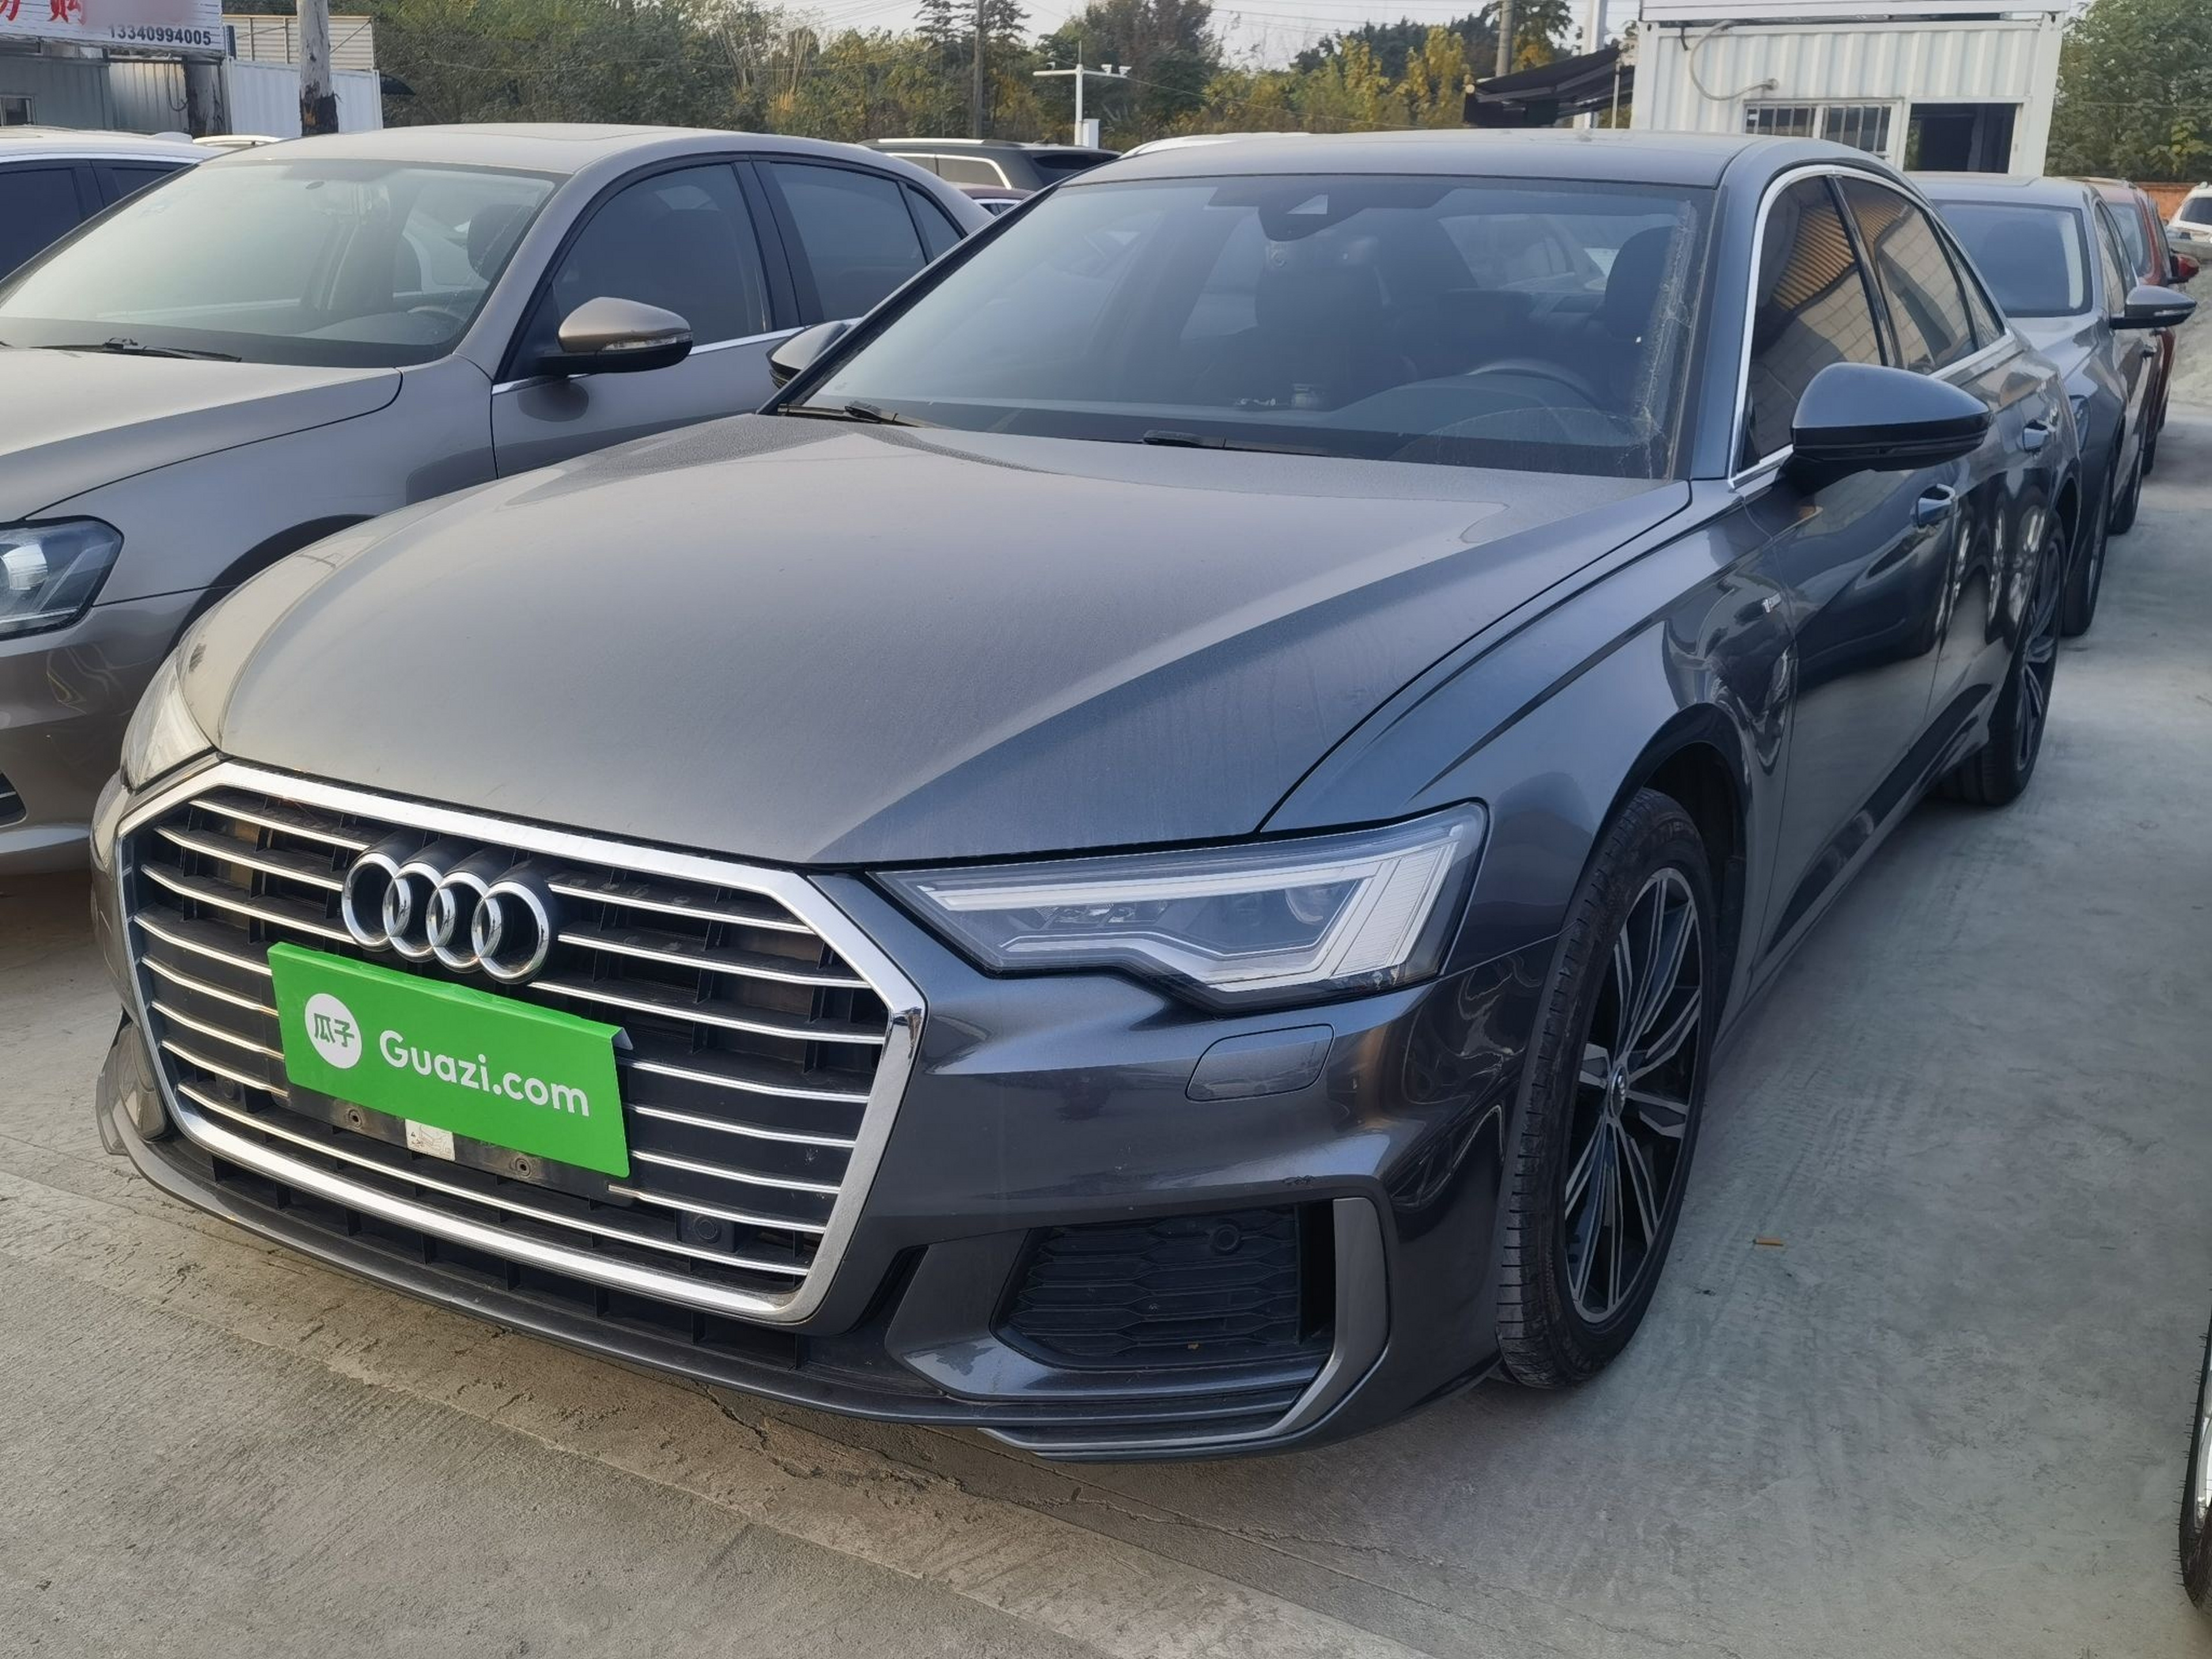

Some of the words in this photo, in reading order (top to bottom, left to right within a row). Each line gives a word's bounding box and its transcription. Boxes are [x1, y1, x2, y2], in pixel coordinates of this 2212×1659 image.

[109, 24, 211, 45] 13340994005
[314, 1013, 354, 1047] 瓜子
[379, 1029, 589, 1117] Guazi.com
